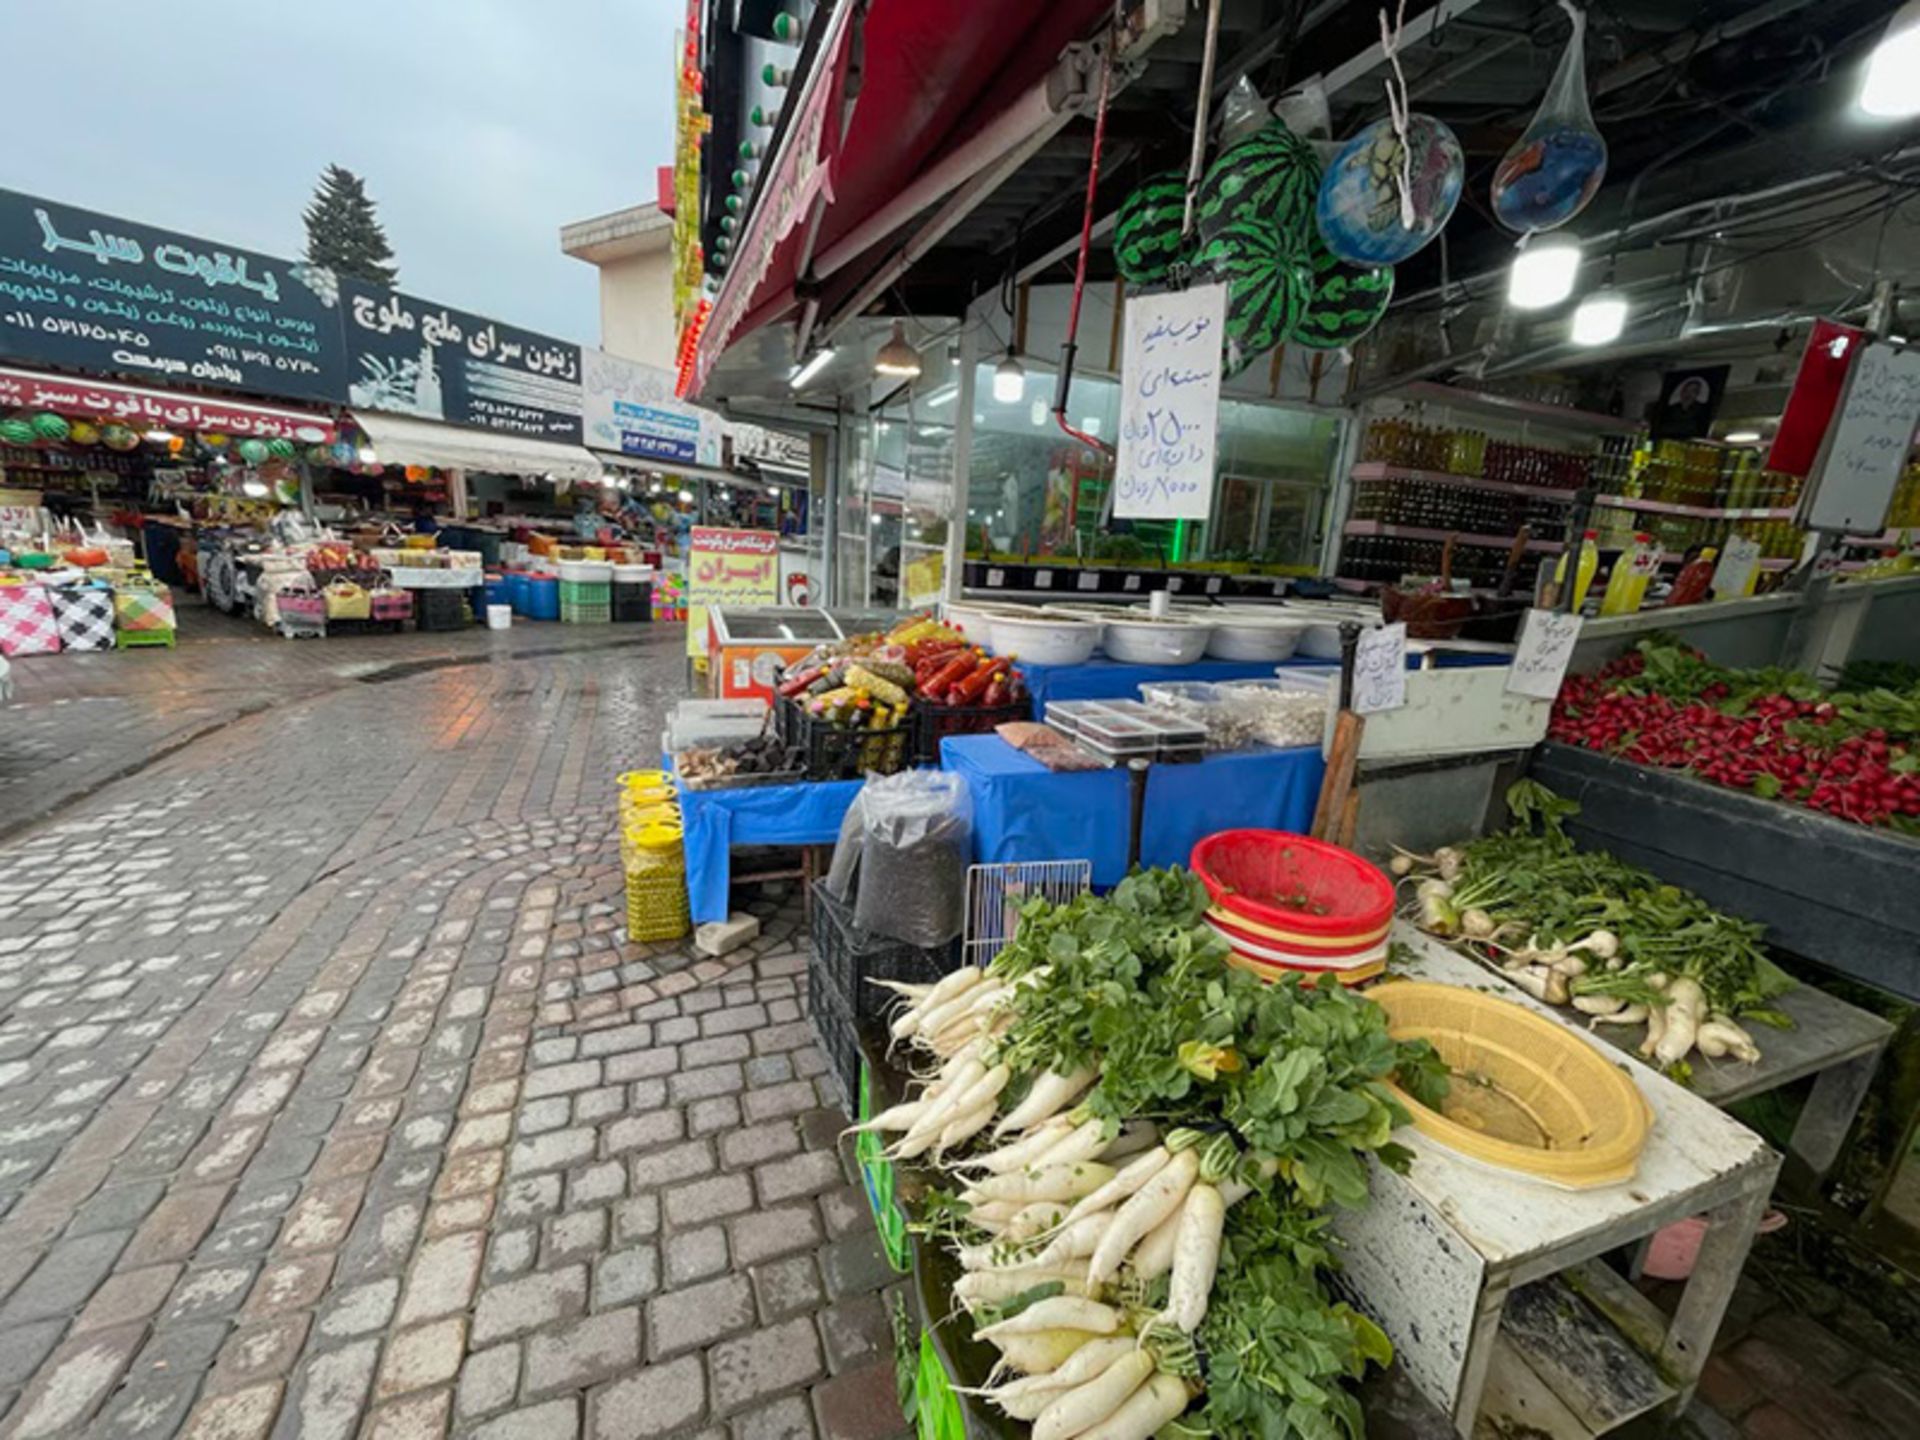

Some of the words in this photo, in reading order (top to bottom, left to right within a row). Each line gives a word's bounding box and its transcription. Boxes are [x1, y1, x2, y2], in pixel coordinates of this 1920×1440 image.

[155, 244, 278, 301] یاقوت
[4, 311, 35, 328] ۰۱۱
[467, 323, 522, 362] سرای
[525, 343, 577, 380] زیتون
[29, 383, 78, 408] سبز
[84, 390, 163, 418] یاقوت
[165, 405, 231, 428] سرای
[230, 414, 294, 439] زیتون
[697, 556, 772, 584] ایران
